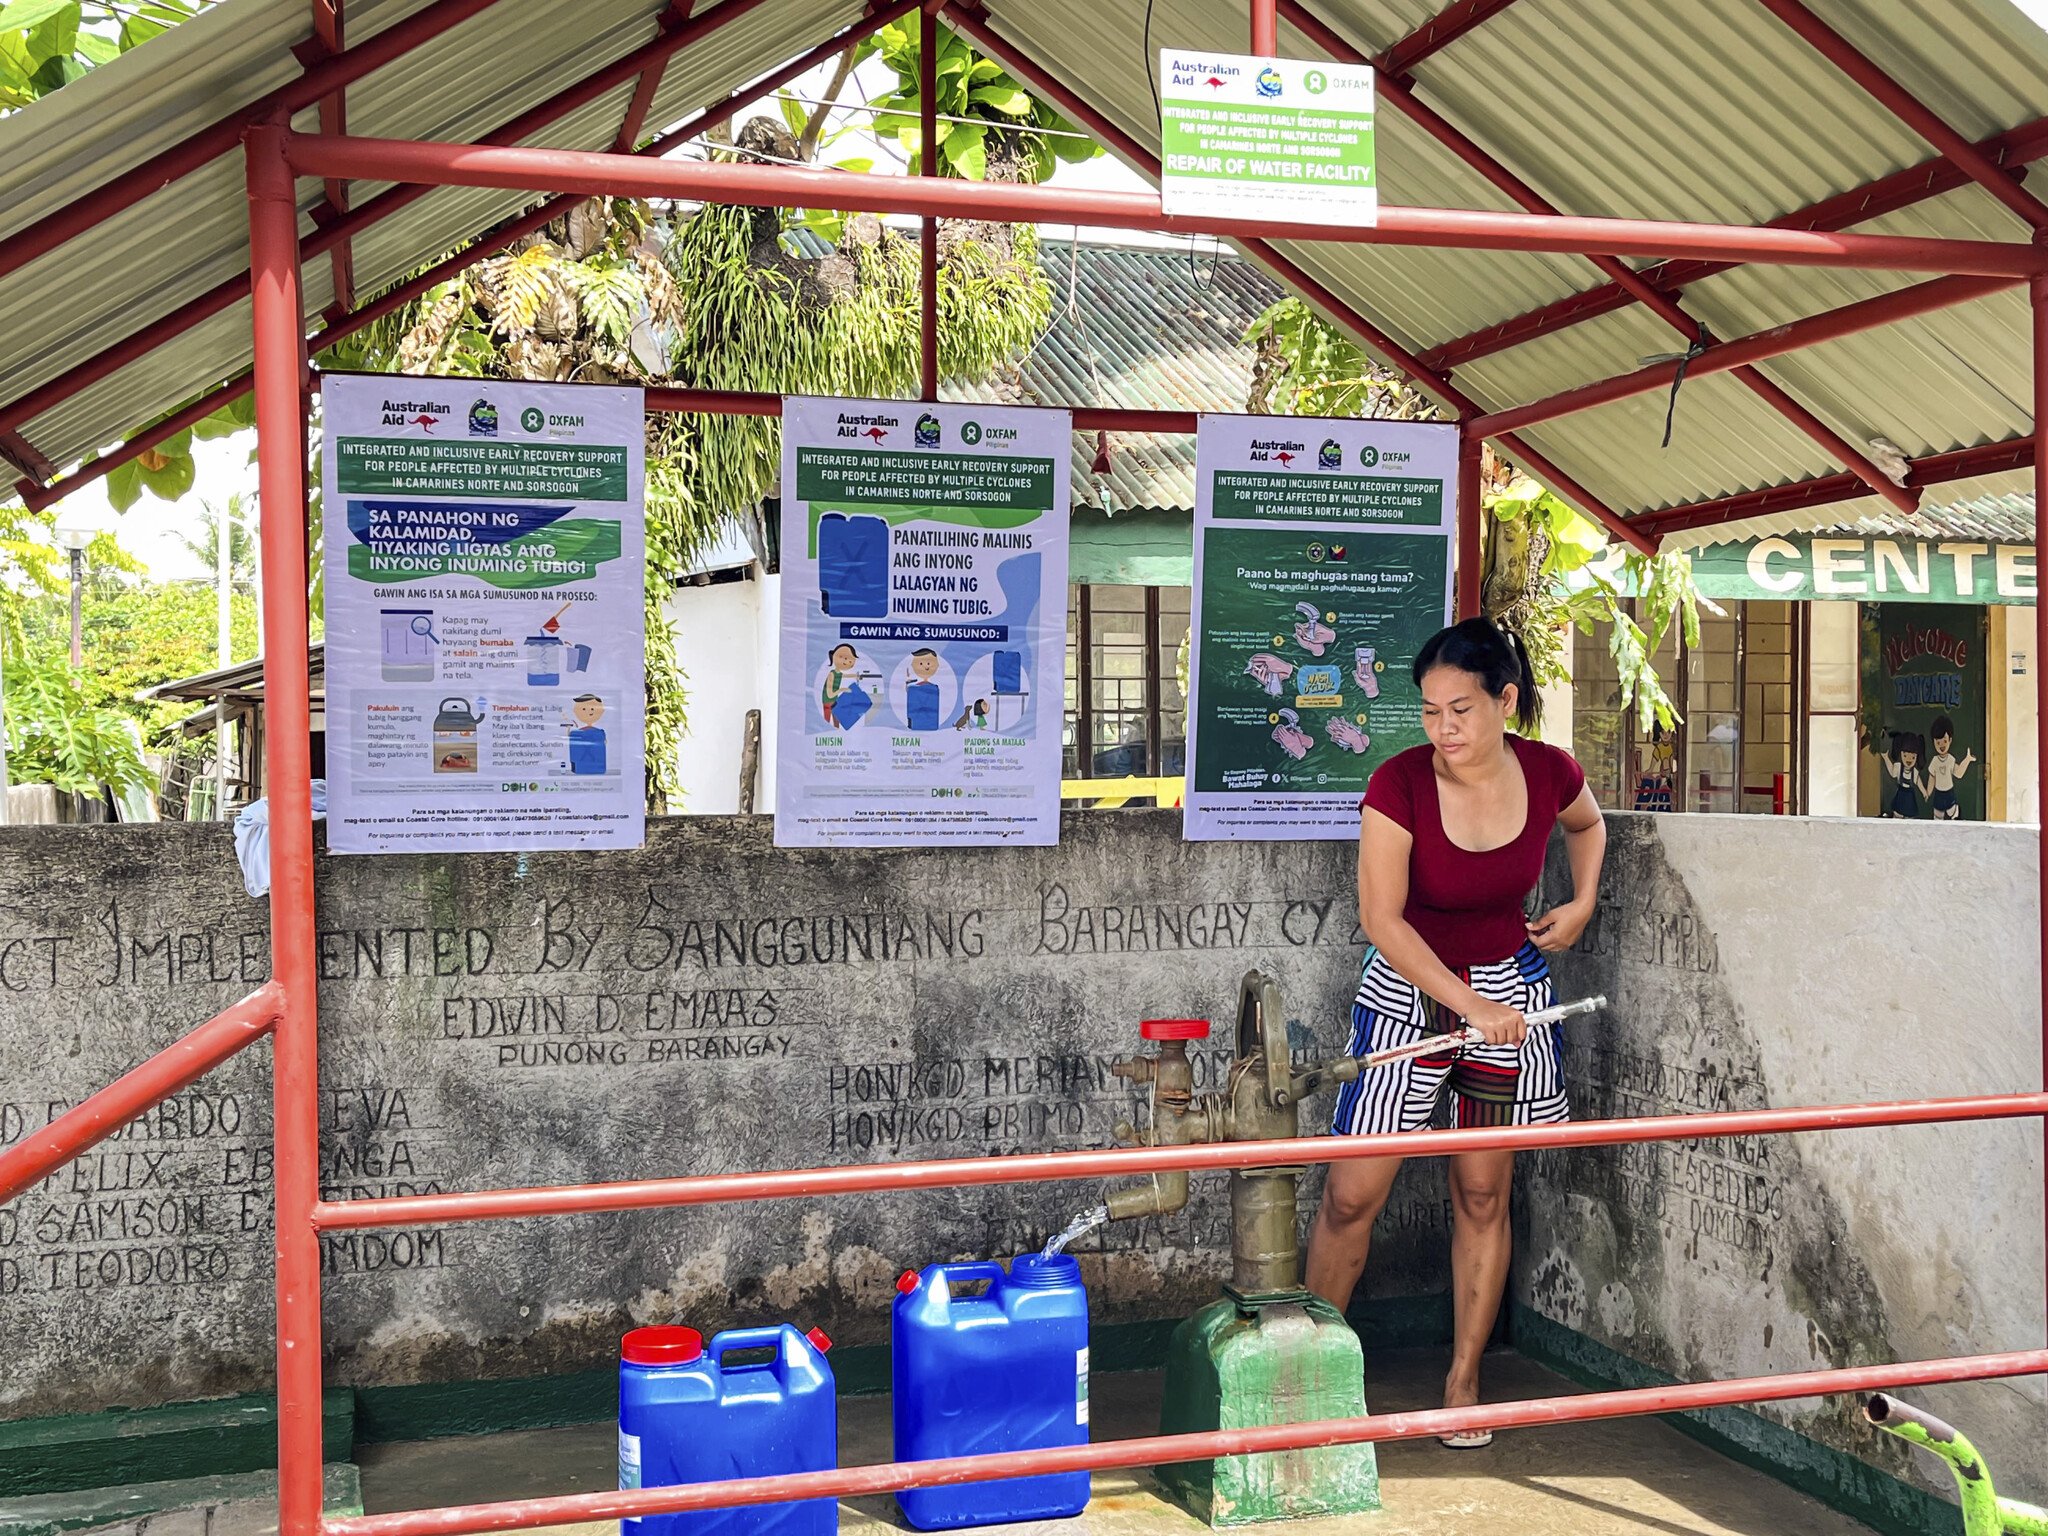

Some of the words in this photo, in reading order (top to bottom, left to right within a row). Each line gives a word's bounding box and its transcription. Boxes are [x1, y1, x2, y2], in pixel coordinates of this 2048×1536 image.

[1172, 60, 1240, 76] Australian
[1172, 74, 1194, 86] Aid
[1333, 78, 1369, 89] OXFAM
[1166, 154, 1222, 174] REPAIR
[1225, 158, 1246, 174] OF
[1249, 160, 1303, 179] WATER
[1305, 162, 1371, 182] FACILITY
[382, 400, 450, 414] Australian
[382, 414, 404, 425] Aid
[549, 415, 584, 427] OXFAM
[837, 413, 898, 427] Australian
[837, 426, 857, 437] Aid
[986, 428, 1017, 439] OXFAM
[1250, 439, 1304, 451] Australian
[343, 444, 405, 456] INTEGRATED
[409, 446, 430, 457] AND
[433, 447, 485, 459] INCLUSIVE
[489, 448, 520, 460] EARLY
[523, 450, 575, 462] RECOVERY
[578, 452, 622, 463] SUPPORT
[1250, 451, 1268, 461] Aid
[1382, 452, 1410, 462] OXFAM
[365, 460, 385, 471] FOR
[388, 461, 427, 473] PEOPLE
[430, 463, 481, 474] AFFECTED
[485, 465, 497, 475] BY
[501, 465, 548, 477] MULTIPLE
[551, 466, 602, 478] CYCLONES
[802, 453, 858, 466] INTEGRATED
[861, 457, 879, 467] AND
[882, 458, 929, 469] INCLUSIVE
[932, 460, 960, 470] EARLY
[962, 461, 1008, 472] RECOVERY
[1011, 463, 1050, 474] SUPPORT
[392, 477, 402, 488] IN
[405, 478, 464, 489] CAMARINES
[468, 479, 500, 490] NORTE
[503, 480, 524, 491] AND
[527, 481, 579, 493] SORSOGON
[821, 470, 839, 480] FOR
[842, 471, 877, 482] PEOPLE
[879, 472, 925, 484] AFFECTED
[928, 475, 940, 484] BY
[942, 475, 984, 486] MULTIPLE
[987, 477, 1032, 488] CYCLONES
[1218, 476, 1268, 487] INTEGRATED
[1270, 479, 1286, 488] AND
[1289, 479, 1330, 489] INCLUSIVE
[1333, 481, 1358, 490] EARLY
[1360, 482, 1401, 492] RECOVERY
[1404, 484, 1439, 493] SUPPORT
[846, 486, 854, 496] IN
[857, 486, 909, 498] CAMARINES
[912, 488, 941, 499] NORTE
[944, 490, 962, 500] AND
[965, 491, 1011, 502] SORSOGON
[1235, 491, 1250, 500] FOR
[1253, 491, 1284, 500] PEOPLE
[1286, 492, 1327, 503] AFFECTED
[1329, 494, 1340, 503] BY
[1342, 495, 1380, 505] MULTIPLE
[1381, 496, 1422, 506] CYCLONES
[369, 510, 391, 523] SA
[397, 511, 486, 526] PANAHON
[492, 513, 519, 526] NG
[1255, 504, 1264, 514] IN
[1266, 505, 1313, 515] CAMARINES
[1315, 507, 1341, 516] NORTE
[1343, 508, 1359, 517] AND
[1361, 508, 1403, 519] SORSOGON
[369, 526, 477, 542] KALAMIDAD,
[894, 530, 978, 547] PANATILIHING
[982, 532, 1032, 549] MALINIS
[369, 541, 451, 556] TIYAKING
[456, 543, 512, 557] LIGTAS
[517, 545, 557, 558] ANG
[369, 557, 442, 571] INYONG
[448, 559, 527, 573] INUMING
[531, 561, 586, 574] TUBIG!
[893, 553, 920, 568] ANG
[925, 554, 973, 569] INYONG
[1747, 537, 2037, 597] CENTE
[893, 575, 955, 591] LALAGYAN
[960, 577, 978, 592] NG
[1237, 568, 1271, 579] Paano
[1275, 569, 1288, 580] ba
[1291, 569, 1348, 583] maghugas
[1351, 572, 1377, 584] nang
[1380, 572, 1414, 583] tama?
[374, 588, 405, 599] GAWIN
[408, 589, 427, 599] ANG
[429, 589, 444, 599] ISA
[446, 590, 457, 599] SA
[460, 590, 480, 600] MGA
[483, 590, 539, 601] SUMUSUNOD
[541, 591, 554, 601] NA
[556, 592, 598, 602] PROSESO:
[893, 598, 949, 613] INUMING
[953, 600, 992, 615] TUBIG.
[442, 616, 468, 625] Kapag
[442, 628, 478, 636] nakitang
[850, 626, 889, 637] GAWIN
[894, 627, 920, 638] ANG
[924, 627, 1000, 639] SUMUSUNOD:
[442, 639, 478, 647] hayaang
[1885, 623, 1968, 677] Welcome
[443, 661, 466, 669] gamit
[815, 737, 843, 746] LINISIN
[892, 737, 920, 747] TAKPAN
[992, 738, 1000, 746] SA
[964, 747, 973, 755] NA
[975, 747, 995, 755] LUGAR
[443, 996, 565, 1039] EDWIN
[499, 1043, 626, 1066] PUNONG
[648, 1035, 792, 1062] BARANGAY
[36, 1200, 204, 1244] SAMSON
